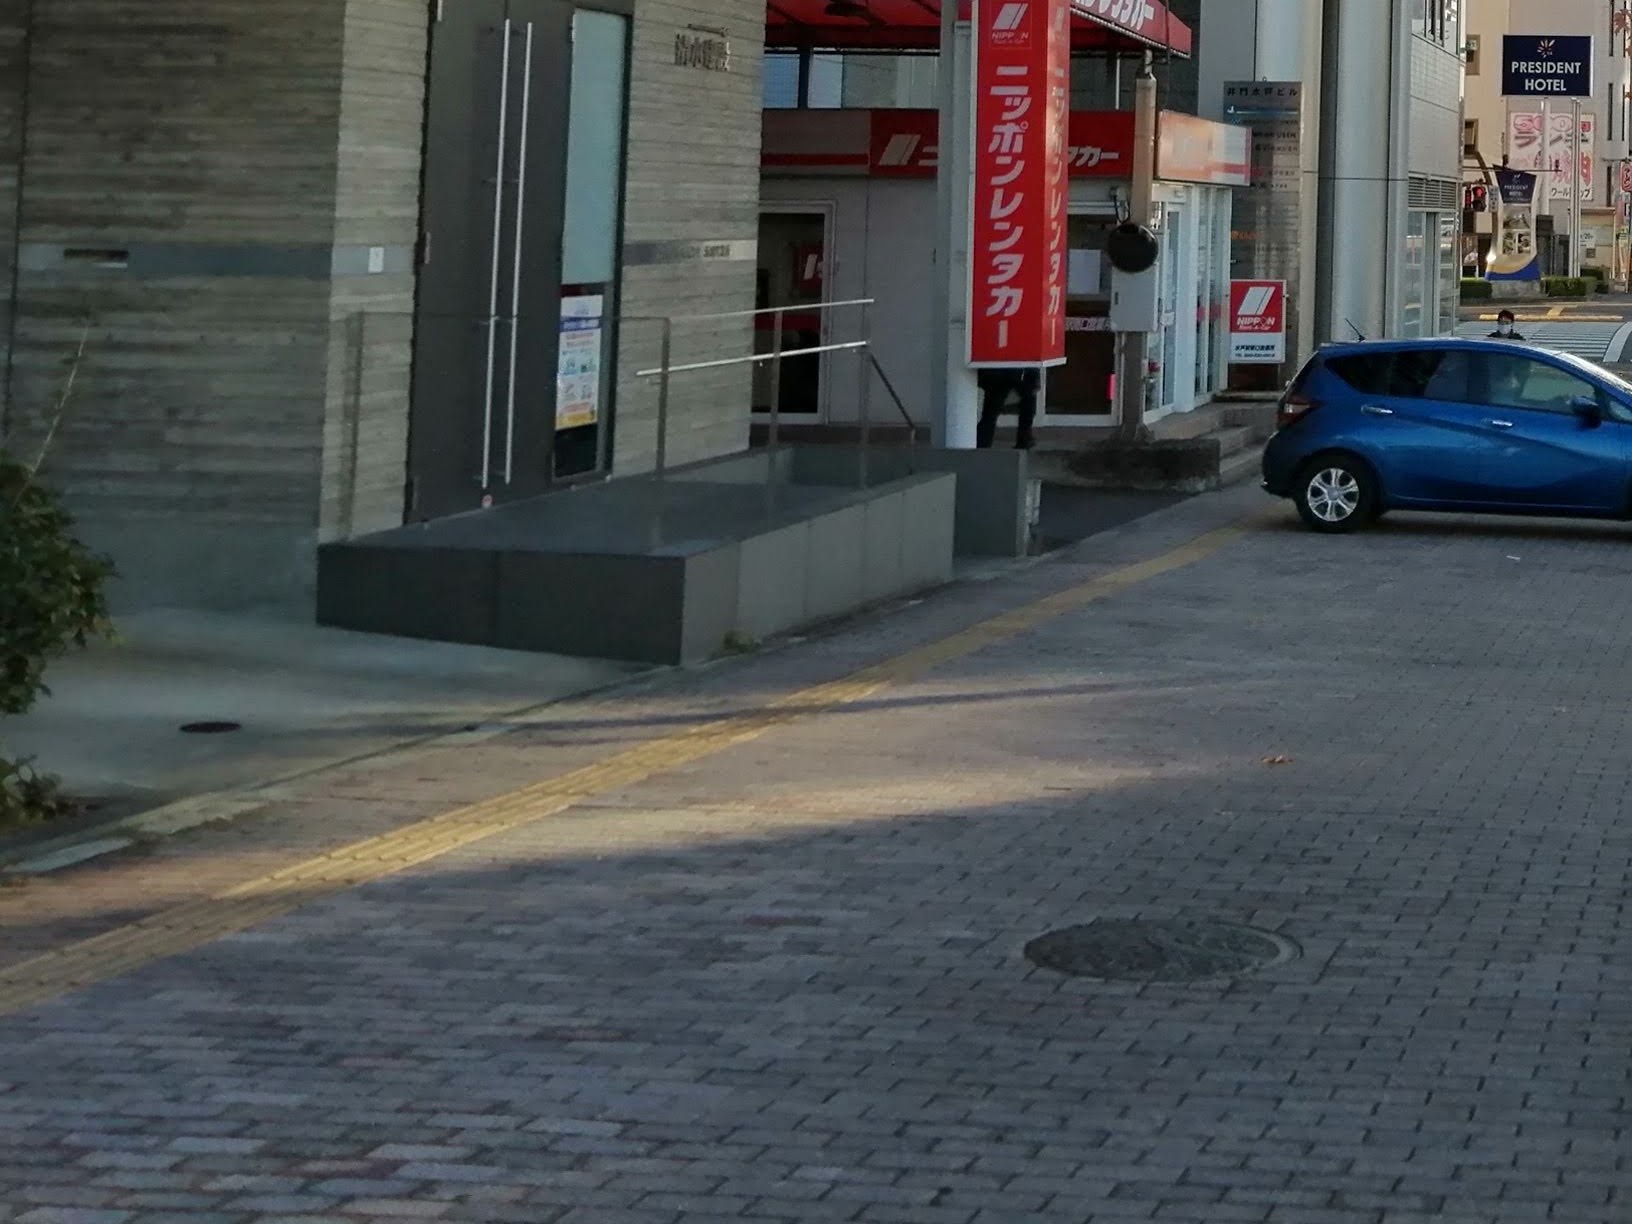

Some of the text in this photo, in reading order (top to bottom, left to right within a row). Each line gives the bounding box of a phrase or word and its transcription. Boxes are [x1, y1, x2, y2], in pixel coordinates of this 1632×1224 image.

[1511, 61, 1582, 75] PRESIDENT
[1524, 78, 1567, 92] HOTEL
[986, 65, 1033, 350] ニッポンレンタカー
[1047, 67, 1066, 347] ニッポンレンタカー
